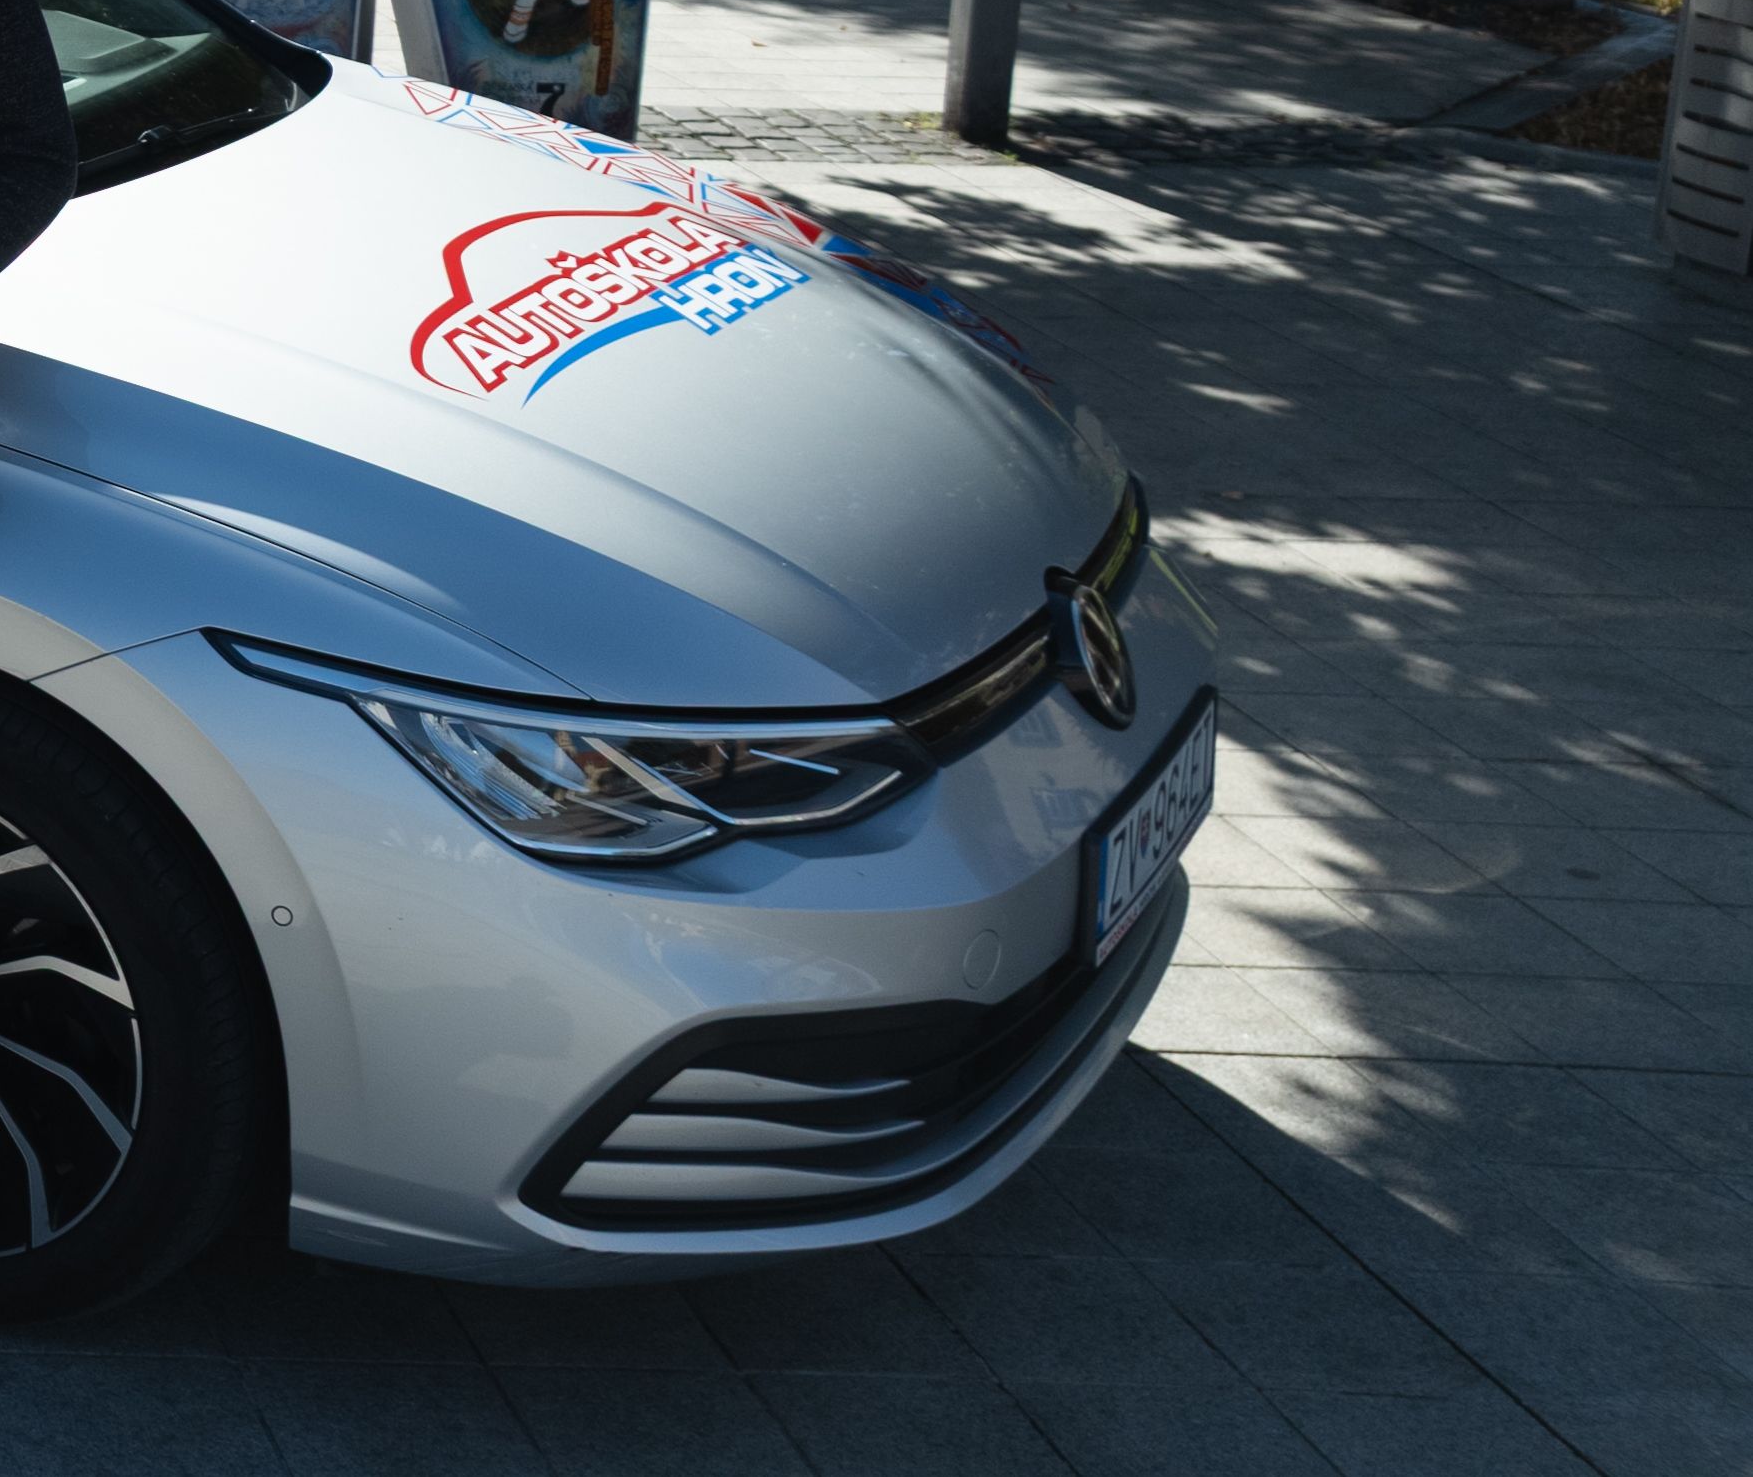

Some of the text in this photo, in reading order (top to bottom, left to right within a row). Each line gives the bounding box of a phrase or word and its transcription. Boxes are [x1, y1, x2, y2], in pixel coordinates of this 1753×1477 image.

[448, 215, 742, 388] AUTOŠKOLA
[654, 247, 806, 332] HRON
[1109, 807, 1143, 917] ZV
